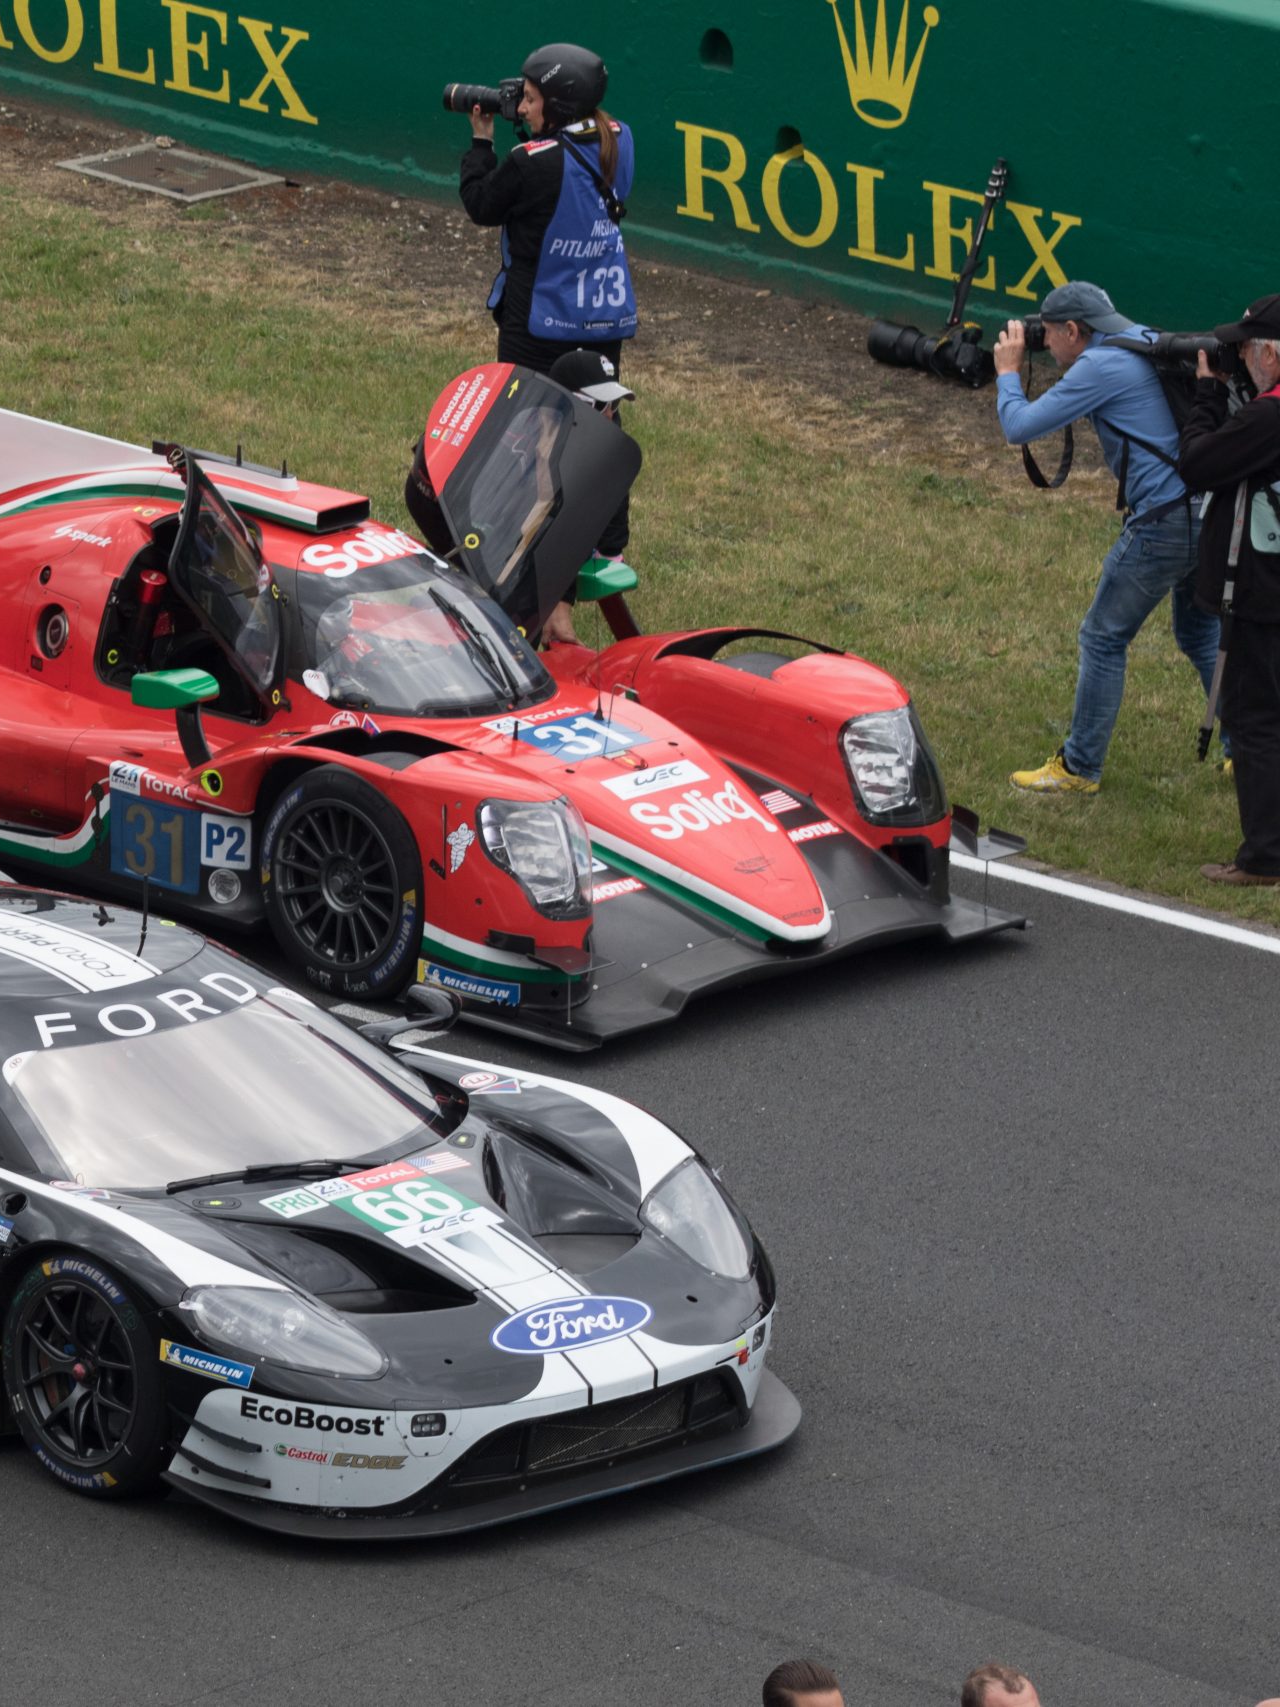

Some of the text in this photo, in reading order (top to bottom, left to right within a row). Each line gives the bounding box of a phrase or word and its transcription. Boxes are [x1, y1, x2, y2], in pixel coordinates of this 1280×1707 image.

[675, 121, 1082, 302] ROLEX
[549, 238, 607, 258] PITLANE
[576, 265, 626, 308] 133
[439, 380, 469, 425] GONZALEZ
[449, 373, 484, 429] MALDONADO
[459, 387, 490, 433] DAVIDSON
[303, 528, 449, 578] Soliq
[534, 716, 634, 755] 31
[143, 773, 193, 803] TOTAL
[633, 765, 683, 786] WEC
[630, 780, 777, 840] Soliq
[125, 804, 185, 886] 31
[205, 822, 246, 862] P2
[787, 822, 841, 842] MOTUL
[374, 918, 411, 981] MICHELIN
[443, 975, 510, 999] MICHELIN
[34, 972, 257, 1048] FORD
[351, 1168, 416, 1186] TOTAL
[270, 1192, 320, 1215] PRO
[351, 1181, 463, 1228] 66
[419, 1212, 474, 1234] WEC
[62, 1259, 120, 1299] MICHELIN
[526, 1302, 625, 1347] Ford
[182, 1354, 244, 1379] MICHELIN
[240, 1395, 385, 1436] EcoBoost
[35, 1449, 94, 1488] MICHELIN
[287, 1446, 409, 1470] Castrol EDGE
